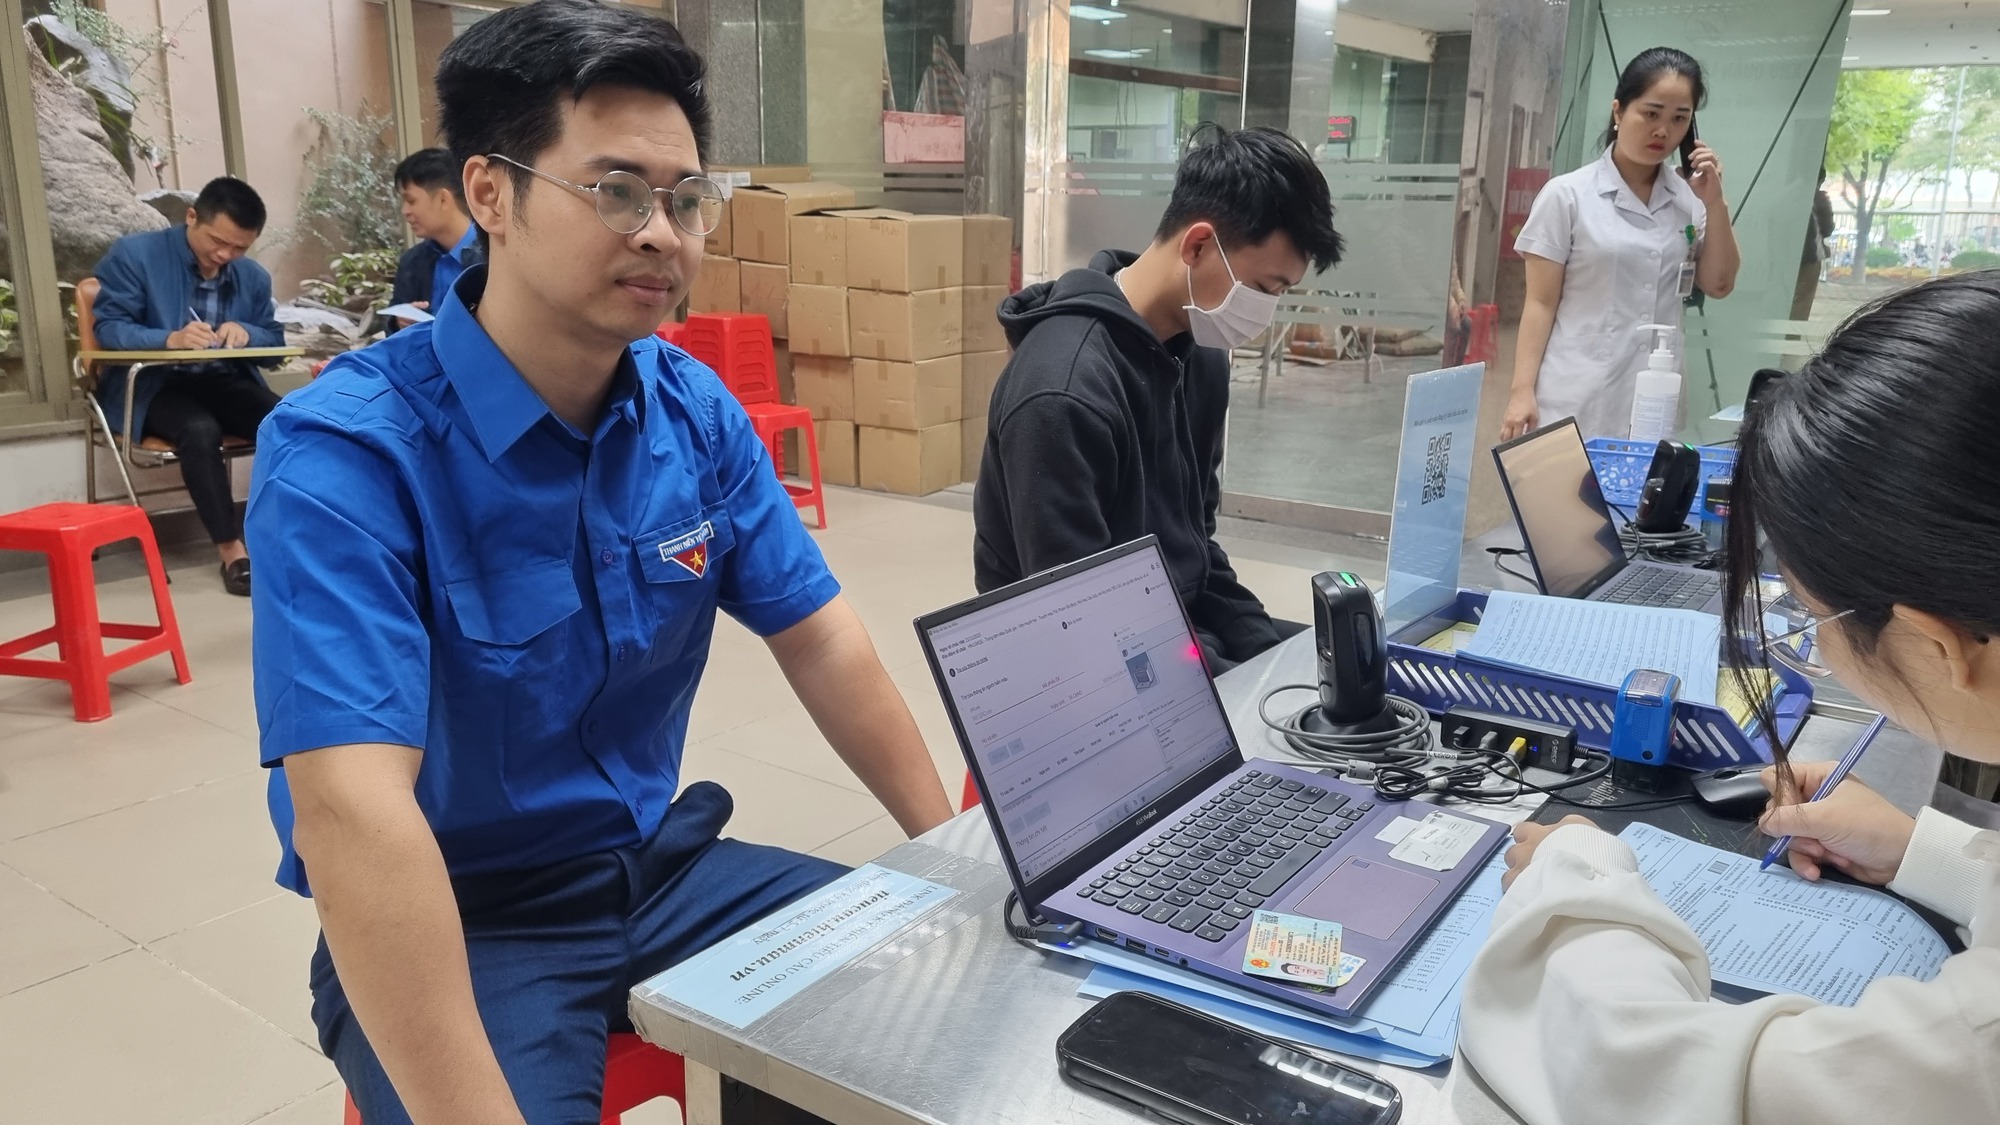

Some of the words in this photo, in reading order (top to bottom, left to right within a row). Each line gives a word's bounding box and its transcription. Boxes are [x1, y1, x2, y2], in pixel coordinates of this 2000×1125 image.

[912, 885, 938, 900] LINK
[729, 889, 890, 982] tieucau.hienmau.vn
[734, 972, 788, 1005] ONLINE:
